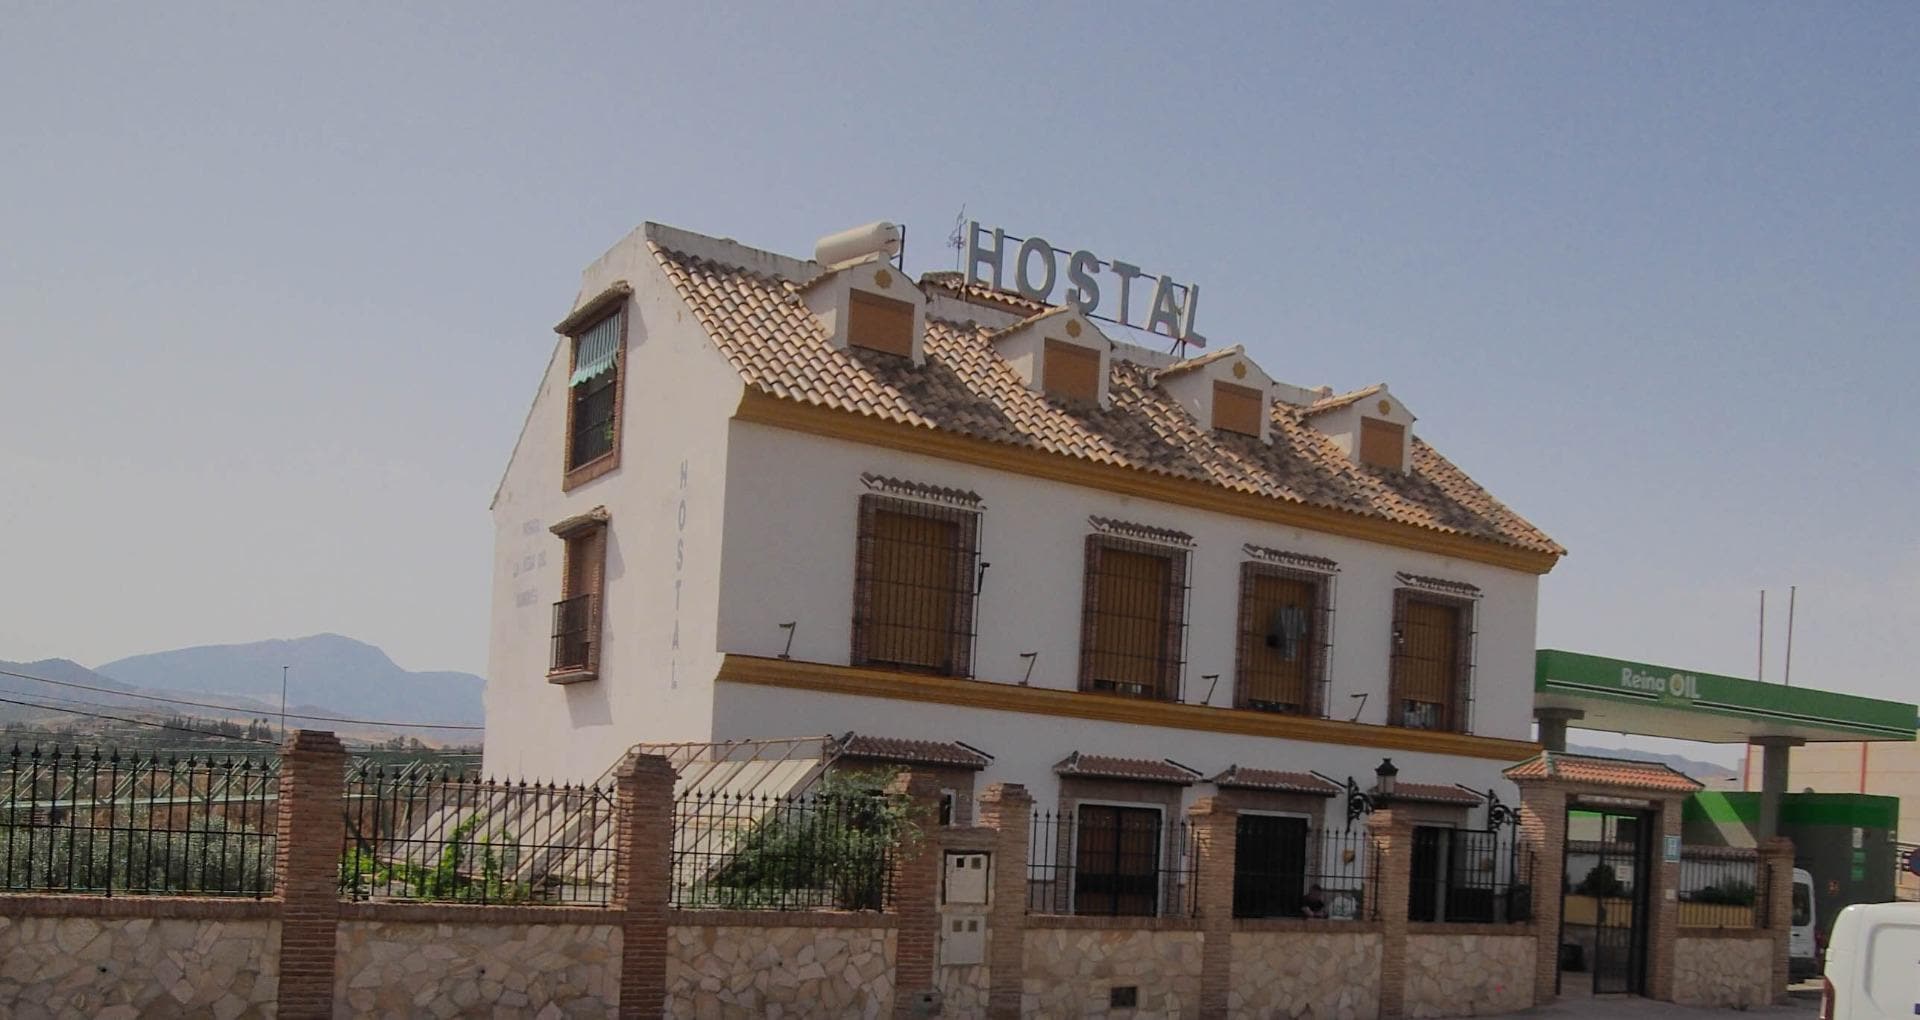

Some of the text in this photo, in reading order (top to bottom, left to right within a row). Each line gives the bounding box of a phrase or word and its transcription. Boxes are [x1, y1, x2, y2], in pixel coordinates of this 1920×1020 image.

[965, 221, 1206, 348] HOSTAL
[672, 460, 688, 689] HOSTAL
[1622, 667, 1702, 699] Reina OIL
